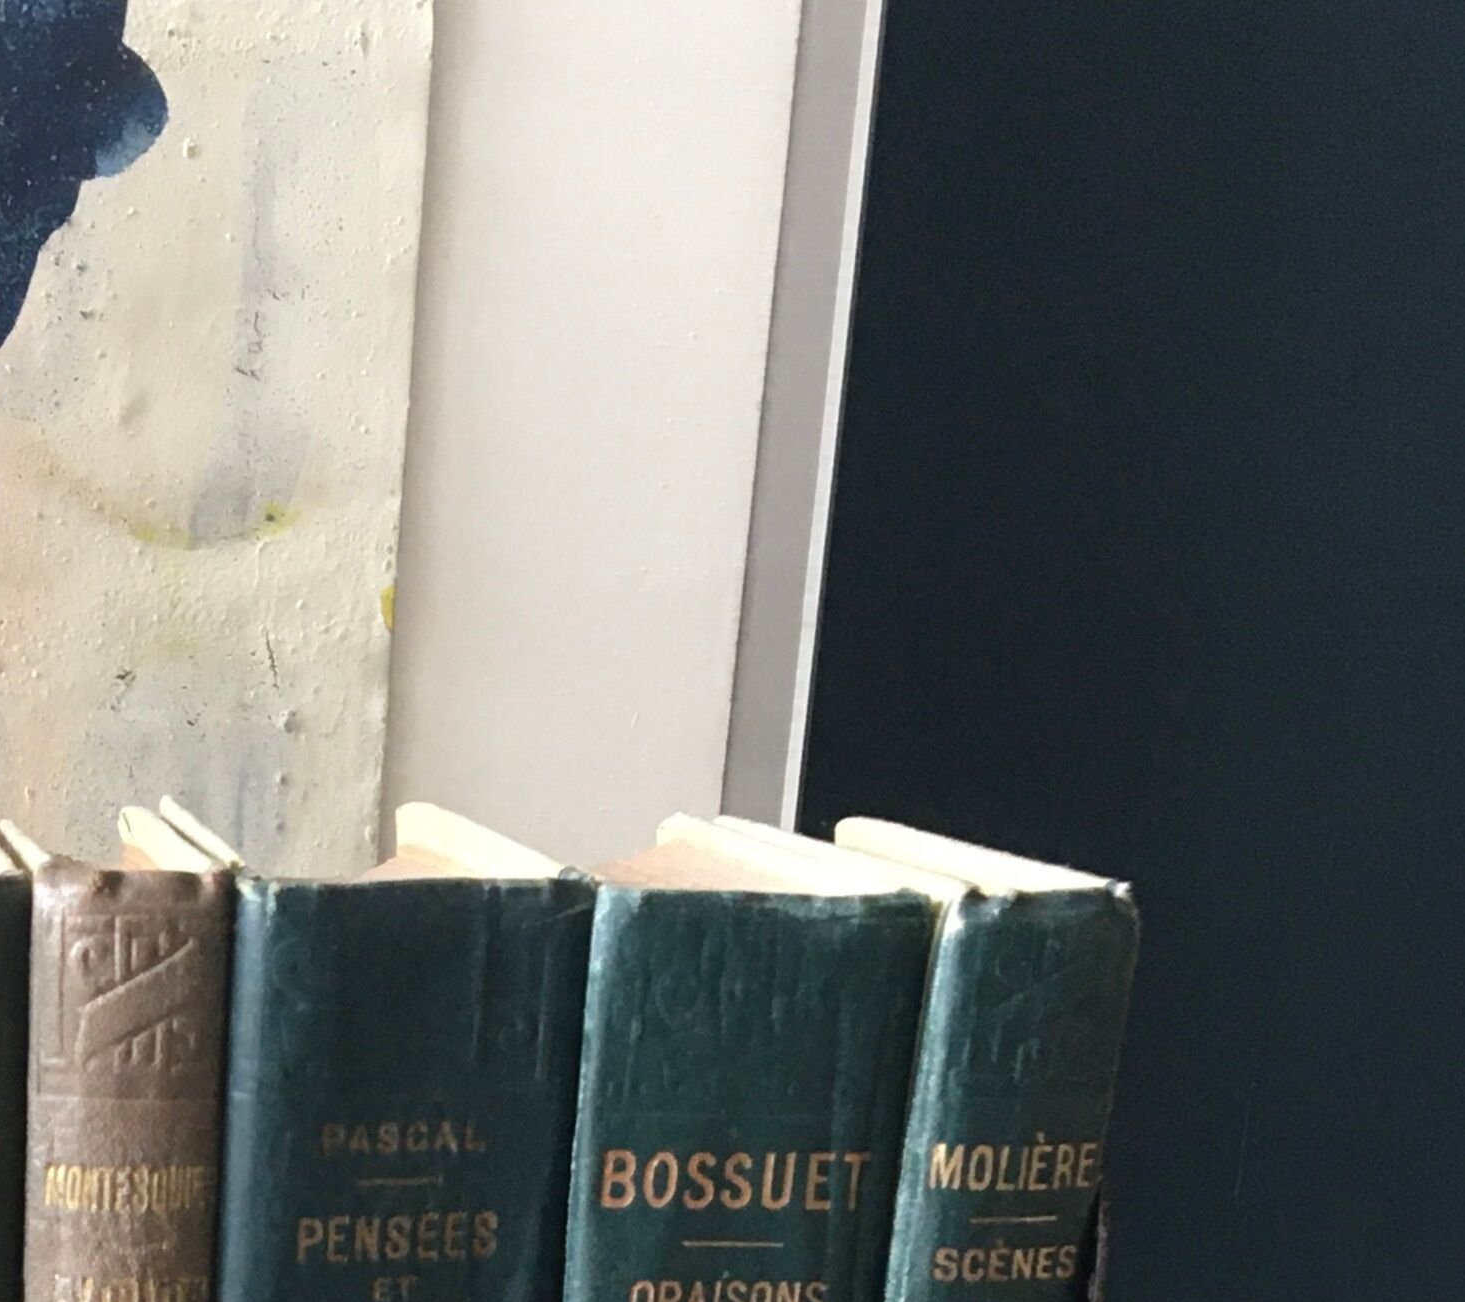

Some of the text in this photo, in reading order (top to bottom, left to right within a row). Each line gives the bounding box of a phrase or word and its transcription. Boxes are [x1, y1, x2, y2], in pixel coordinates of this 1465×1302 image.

[322, 1121, 487, 1155] PASCAL
[929, 1131, 1100, 1192] MOLIÈRE
[600, 1149, 871, 1212] BOSSUET
[297, 1201, 498, 1264] PENSÉES
[934, 1239, 1077, 1282] SCÈNES
